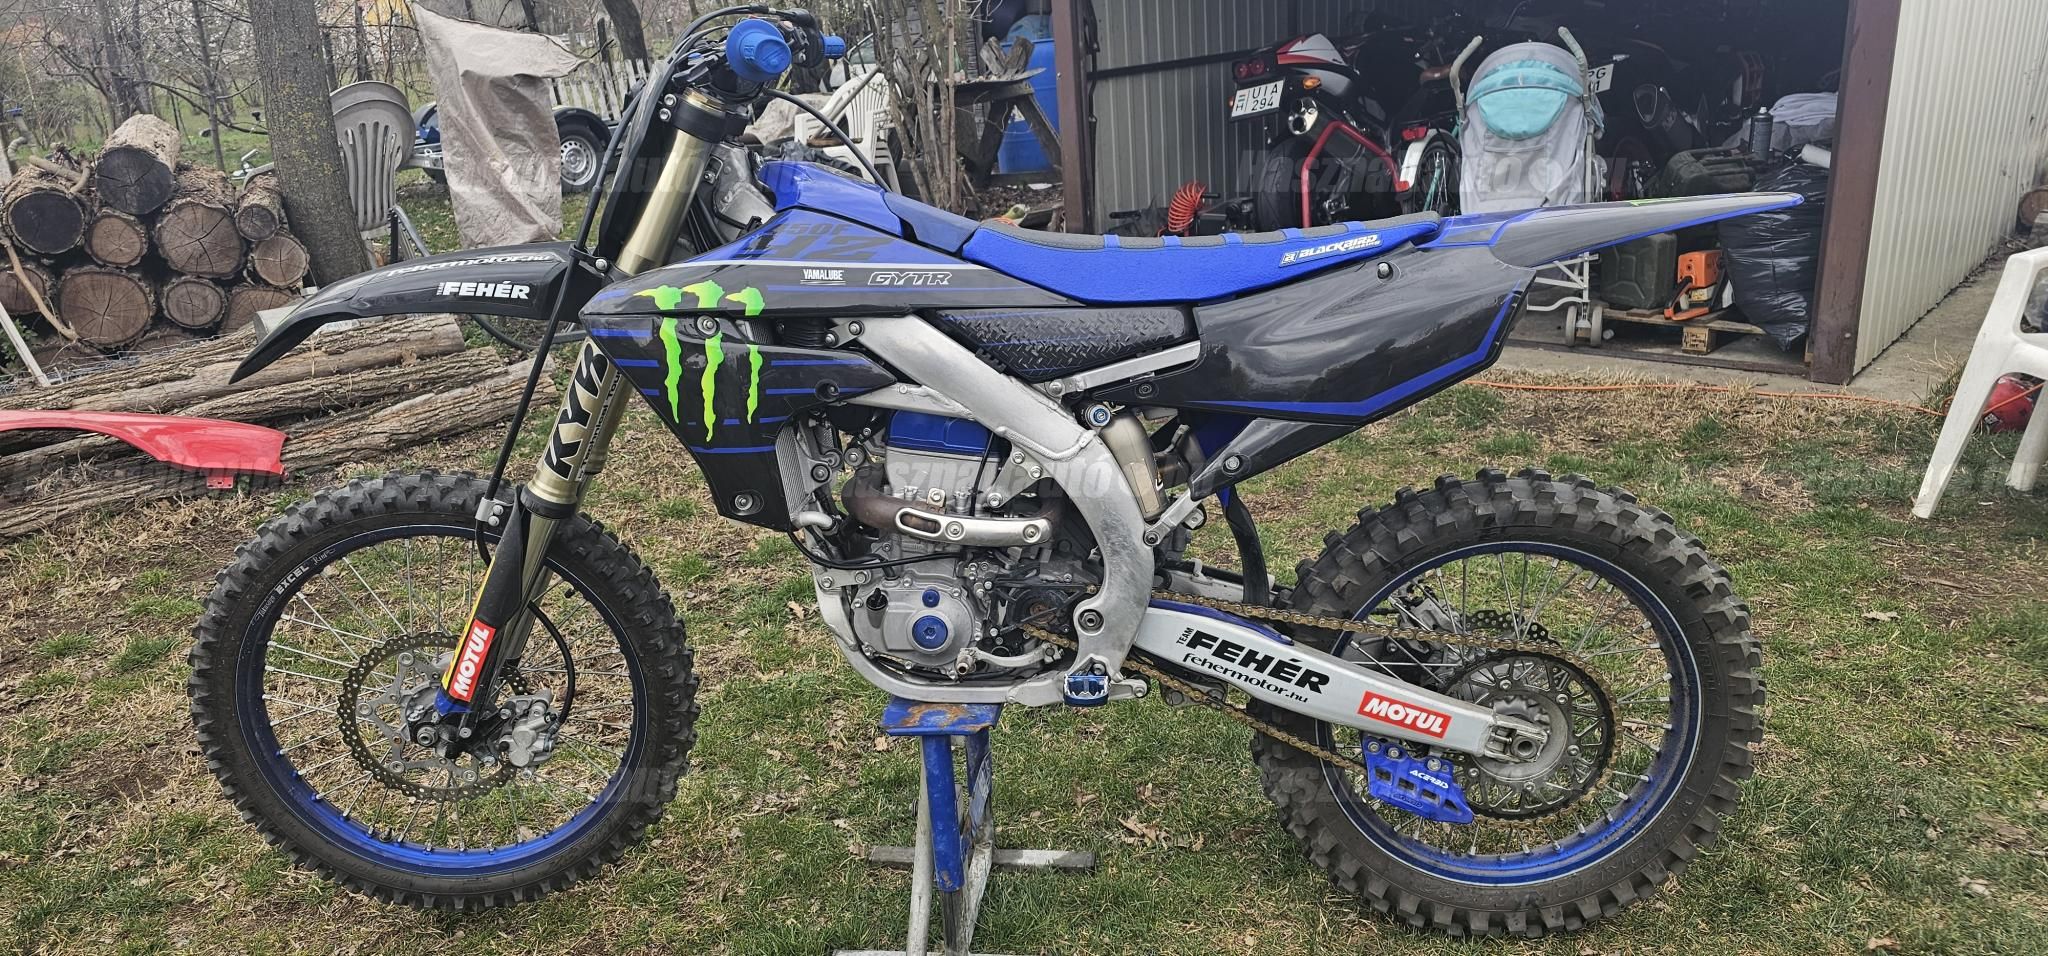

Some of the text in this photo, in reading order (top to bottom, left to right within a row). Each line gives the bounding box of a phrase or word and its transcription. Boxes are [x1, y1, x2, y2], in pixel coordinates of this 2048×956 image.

[1251, 95, 1274, 111] 294
[1252, 83, 1278, 99] UIA
[1299, 234, 1378, 258] BLACKBIRD
[803, 269, 844, 280] YAMALUBE
[868, 271, 953, 286] GYTR
[442, 280, 530, 299] FEHÉR
[543, 342, 609, 480] KYB
[275, 565, 309, 594] EXCEL
[1176, 627, 1195, 645] TEAM
[453, 626, 490, 697] MOTUL
[1186, 630, 1330, 694] FEHÉR
[1182, 652, 1308, 703] fehermotor.hu
[1363, 697, 1444, 734] MOTUL
